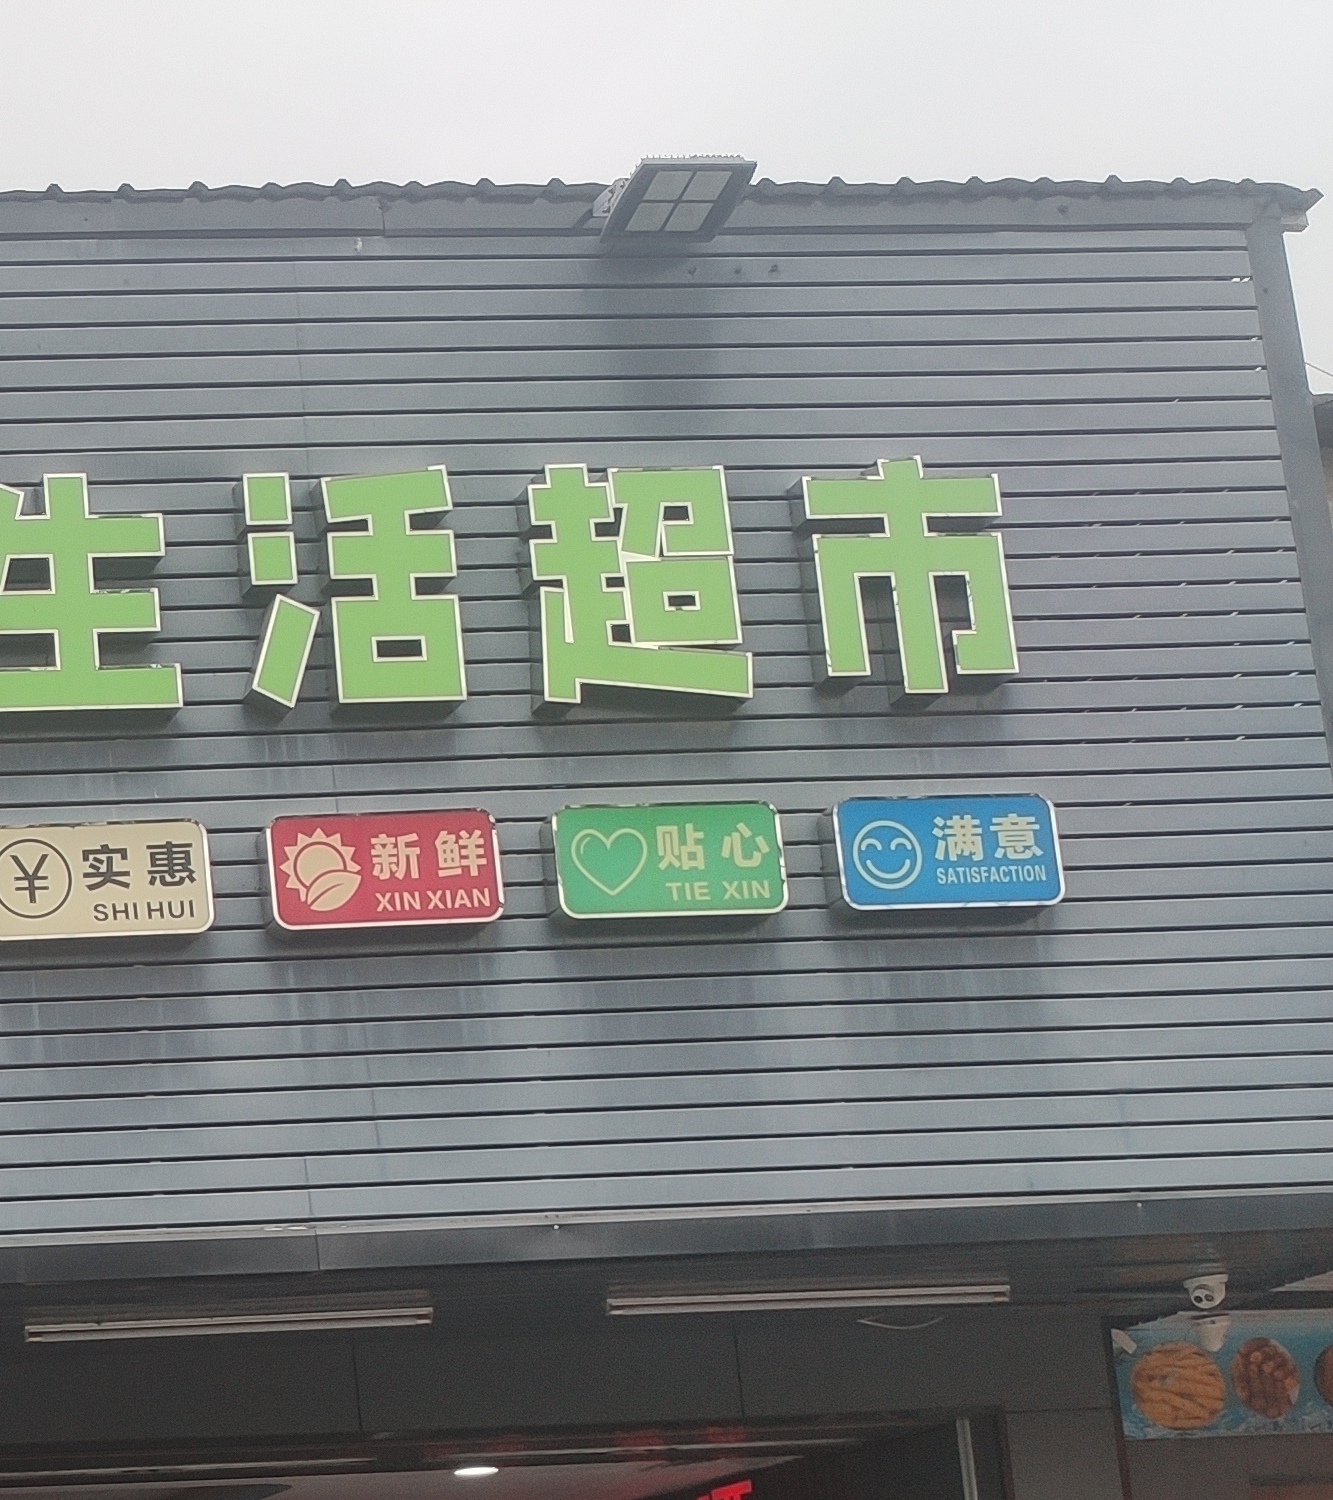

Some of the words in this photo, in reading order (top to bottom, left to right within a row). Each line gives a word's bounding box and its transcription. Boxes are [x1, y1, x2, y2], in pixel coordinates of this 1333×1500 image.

[369, 830, 491, 881] 新鲜
[655, 821, 771, 871] 贴心
[932, 814, 1043, 863] 满意
[81, 840, 197, 892] 实惠
[935, 863, 1048, 886] SATISFACTION
[374, 889, 425, 913] XIN
[427, 886, 492, 910] XIAN
[665, 880, 711, 902] TIE
[721, 878, 771, 900] XIN
[91, 899, 141, 922] SHI
[145, 897, 197, 920] HUI
